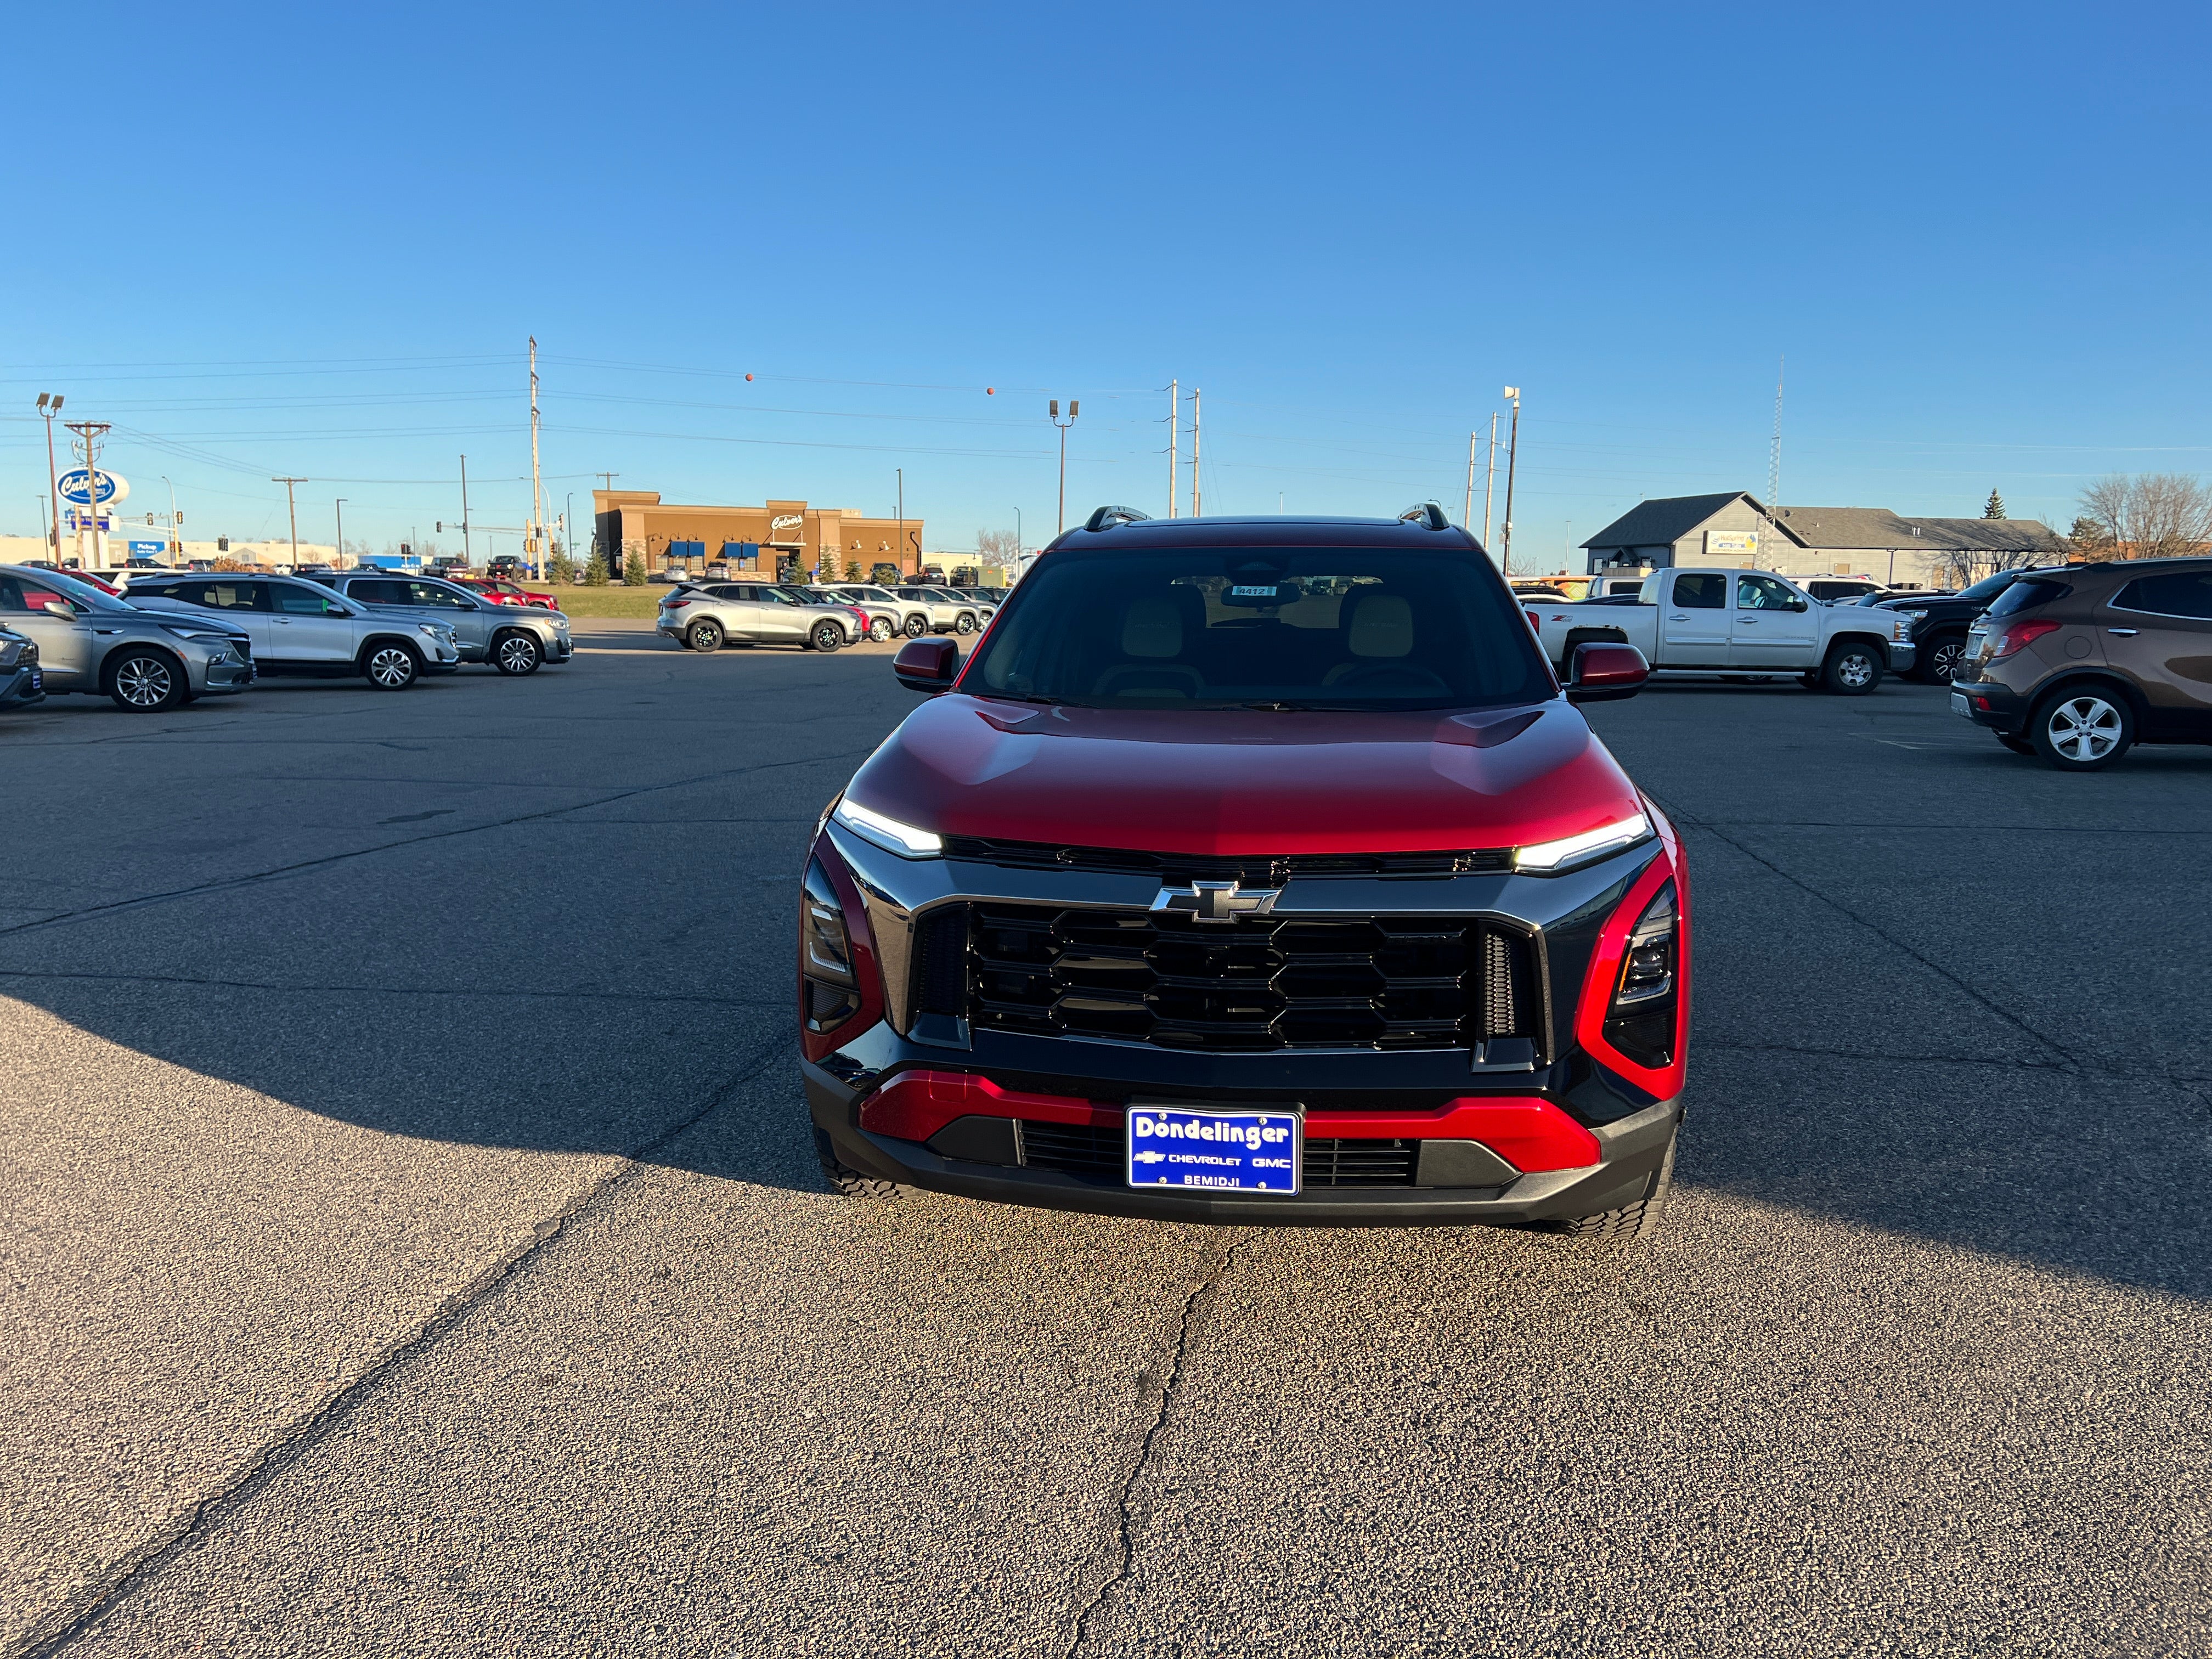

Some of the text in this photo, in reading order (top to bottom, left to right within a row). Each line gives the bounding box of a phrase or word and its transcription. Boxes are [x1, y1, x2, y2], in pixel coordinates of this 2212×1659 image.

[61, 472, 108, 496] Culvr's
[771, 515, 803, 530] Culver's
[1136, 1116, 1289, 1150] Dondelinger
[1169, 1154, 1291, 1168] CHEVROLET GMC
[1184, 1175, 1239, 1187] BEMIDJI
